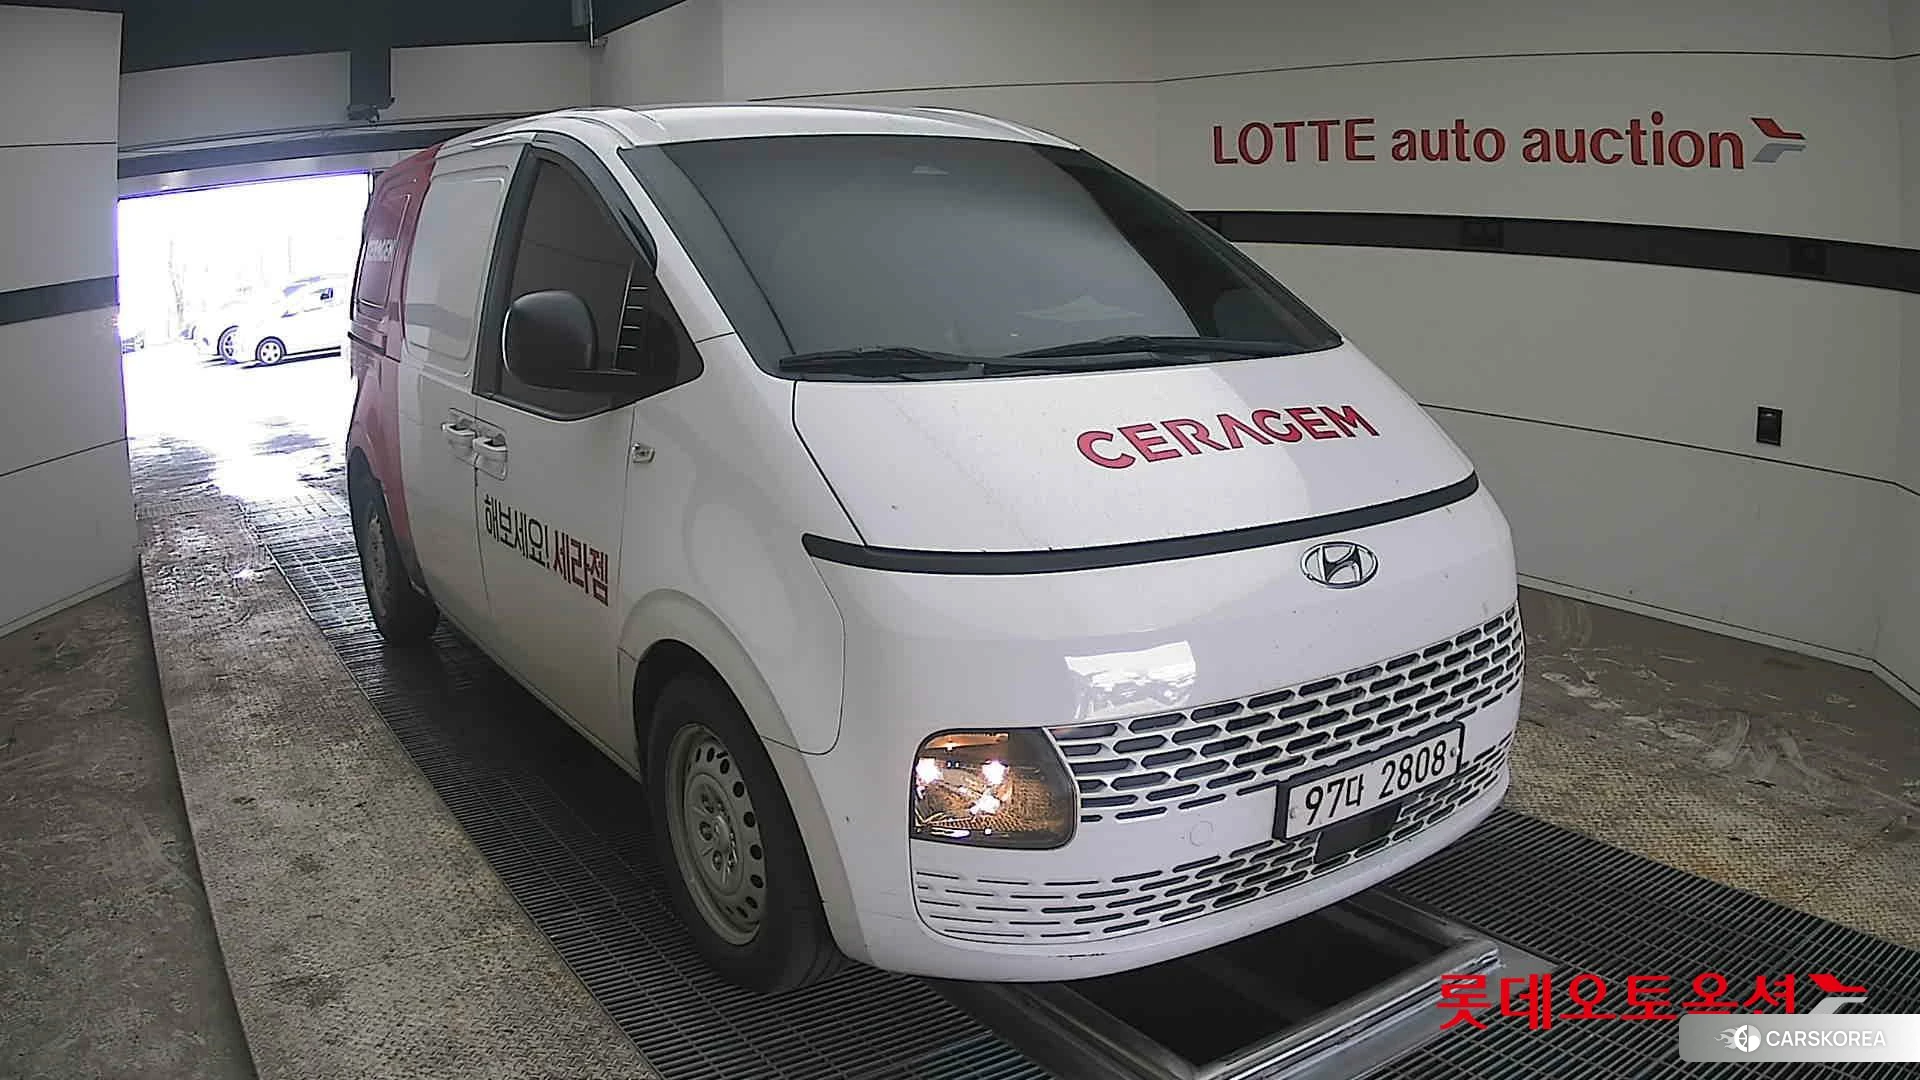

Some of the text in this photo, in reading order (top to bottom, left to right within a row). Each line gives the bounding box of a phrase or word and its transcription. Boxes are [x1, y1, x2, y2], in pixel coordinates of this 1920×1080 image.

[1213, 112, 1744, 169] LOTTE auto auction
[1077, 405, 1380, 469] CERAGEM
[484, 494, 608, 607] 해보세요! 세라젬
[1305, 740, 1446, 826] 97다 2808
